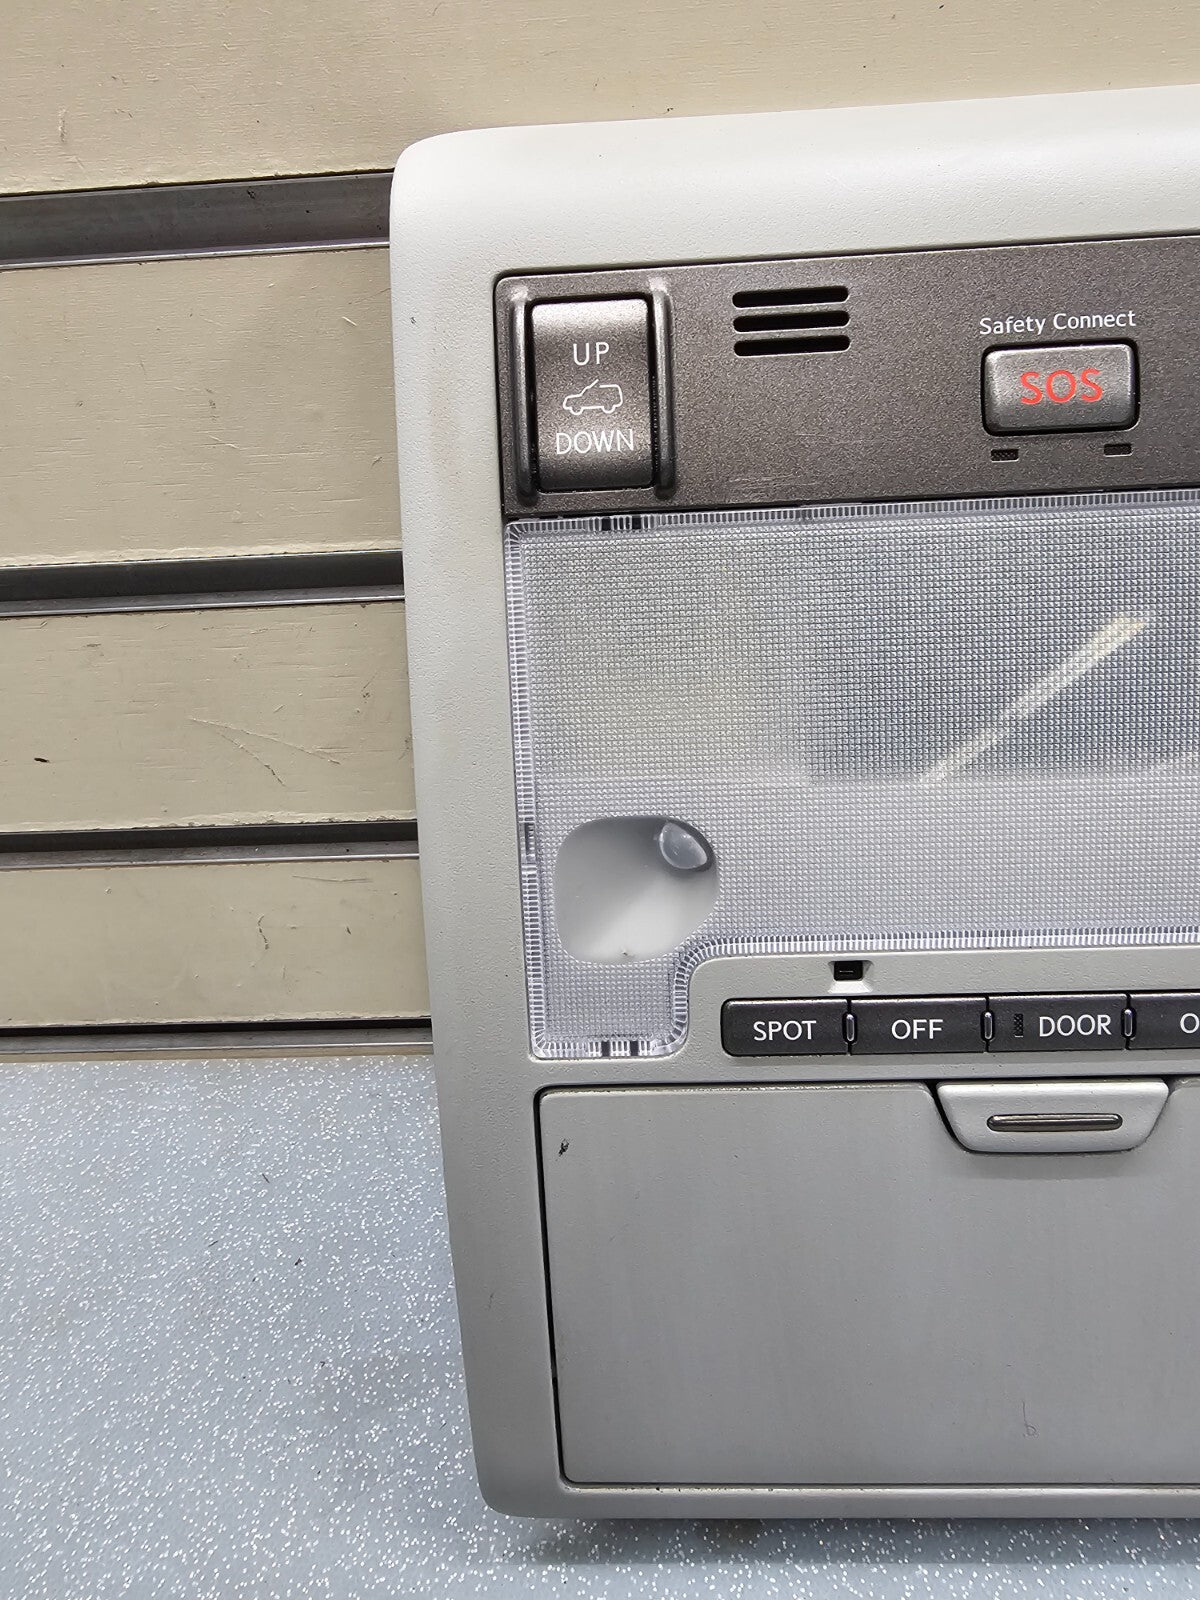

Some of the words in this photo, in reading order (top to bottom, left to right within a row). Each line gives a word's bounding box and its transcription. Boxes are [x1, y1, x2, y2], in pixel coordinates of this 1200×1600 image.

[979, 316, 1046, 336] Safety
[1053, 310, 1136, 330] Connect
[573, 342, 609, 366] UP
[1020, 368, 1103, 405] SOS
[556, 429, 634, 455] DOWN
[753, 1020, 817, 1041] SPOT
[891, 1018, 944, 1040] OFF
[1039, 1014, 1112, 1037] DOOR
